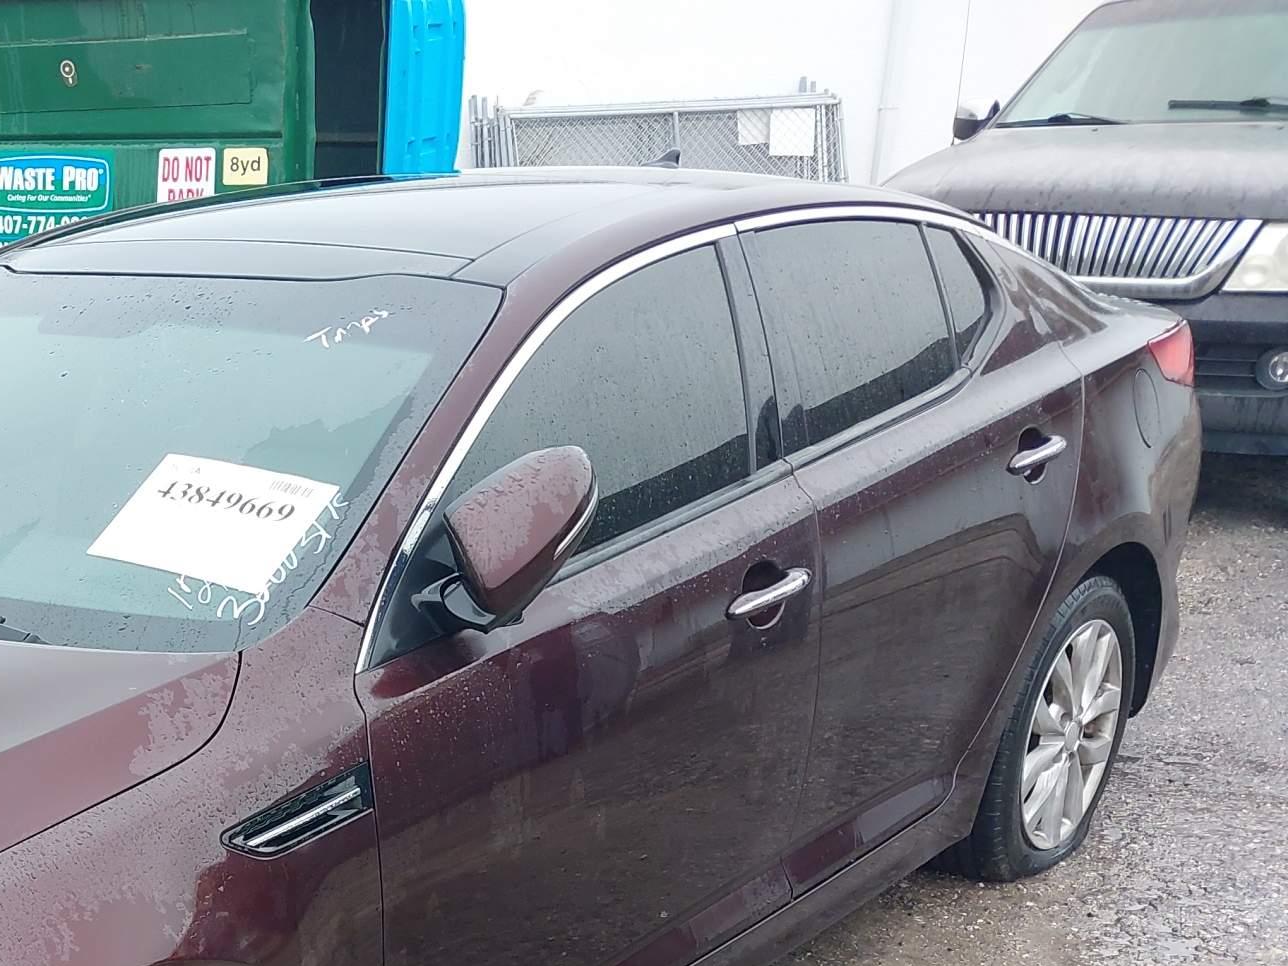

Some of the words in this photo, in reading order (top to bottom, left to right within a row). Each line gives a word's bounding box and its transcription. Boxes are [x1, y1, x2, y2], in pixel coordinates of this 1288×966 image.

[162, 156, 180, 182] DO
[185, 156, 212, 182] NOT
[230, 156, 261, 176] 8yd
[157, 480, 296, 522] 43849669
